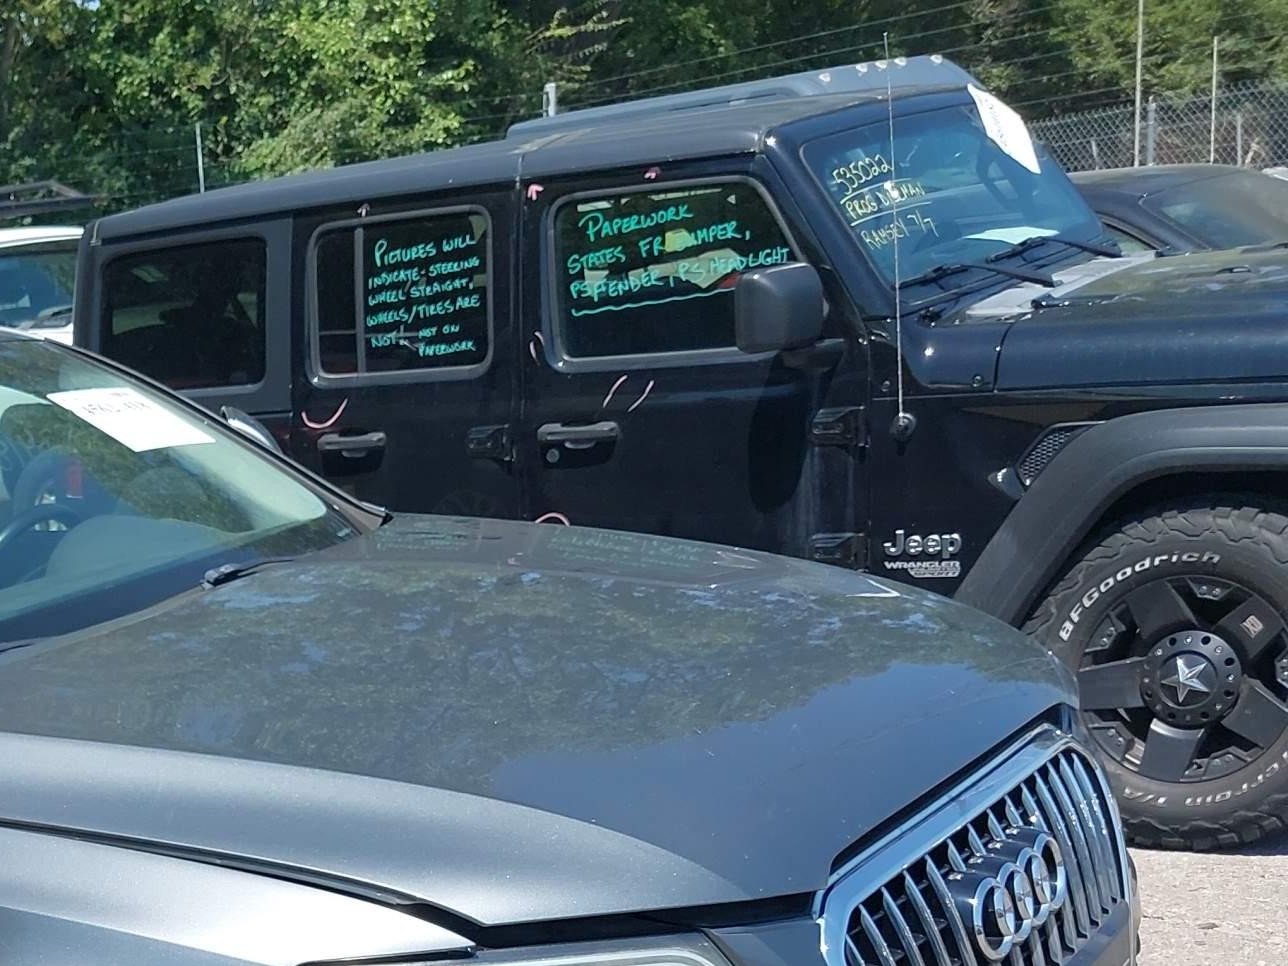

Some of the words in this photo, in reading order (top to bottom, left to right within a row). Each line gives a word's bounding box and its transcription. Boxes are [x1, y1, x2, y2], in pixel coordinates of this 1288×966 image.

[579, 204, 694, 242] PAPERWORK
[374, 239, 436, 267] PICTURES
[442, 234, 476, 252] WILL
[567, 246, 626, 274] STATES
[710, 246, 789, 273] HEADLIGHT
[428, 256, 480, 277] STEERING
[368, 289, 406, 306] WHEEL
[455, 295, 481, 311] ARE
[442, 325, 460, 334] ON
[883, 529, 962, 559] Jeep
[883, 561, 961, 570] WRANGLER
[1058, 550, 1221, 642] BFGoodrich
